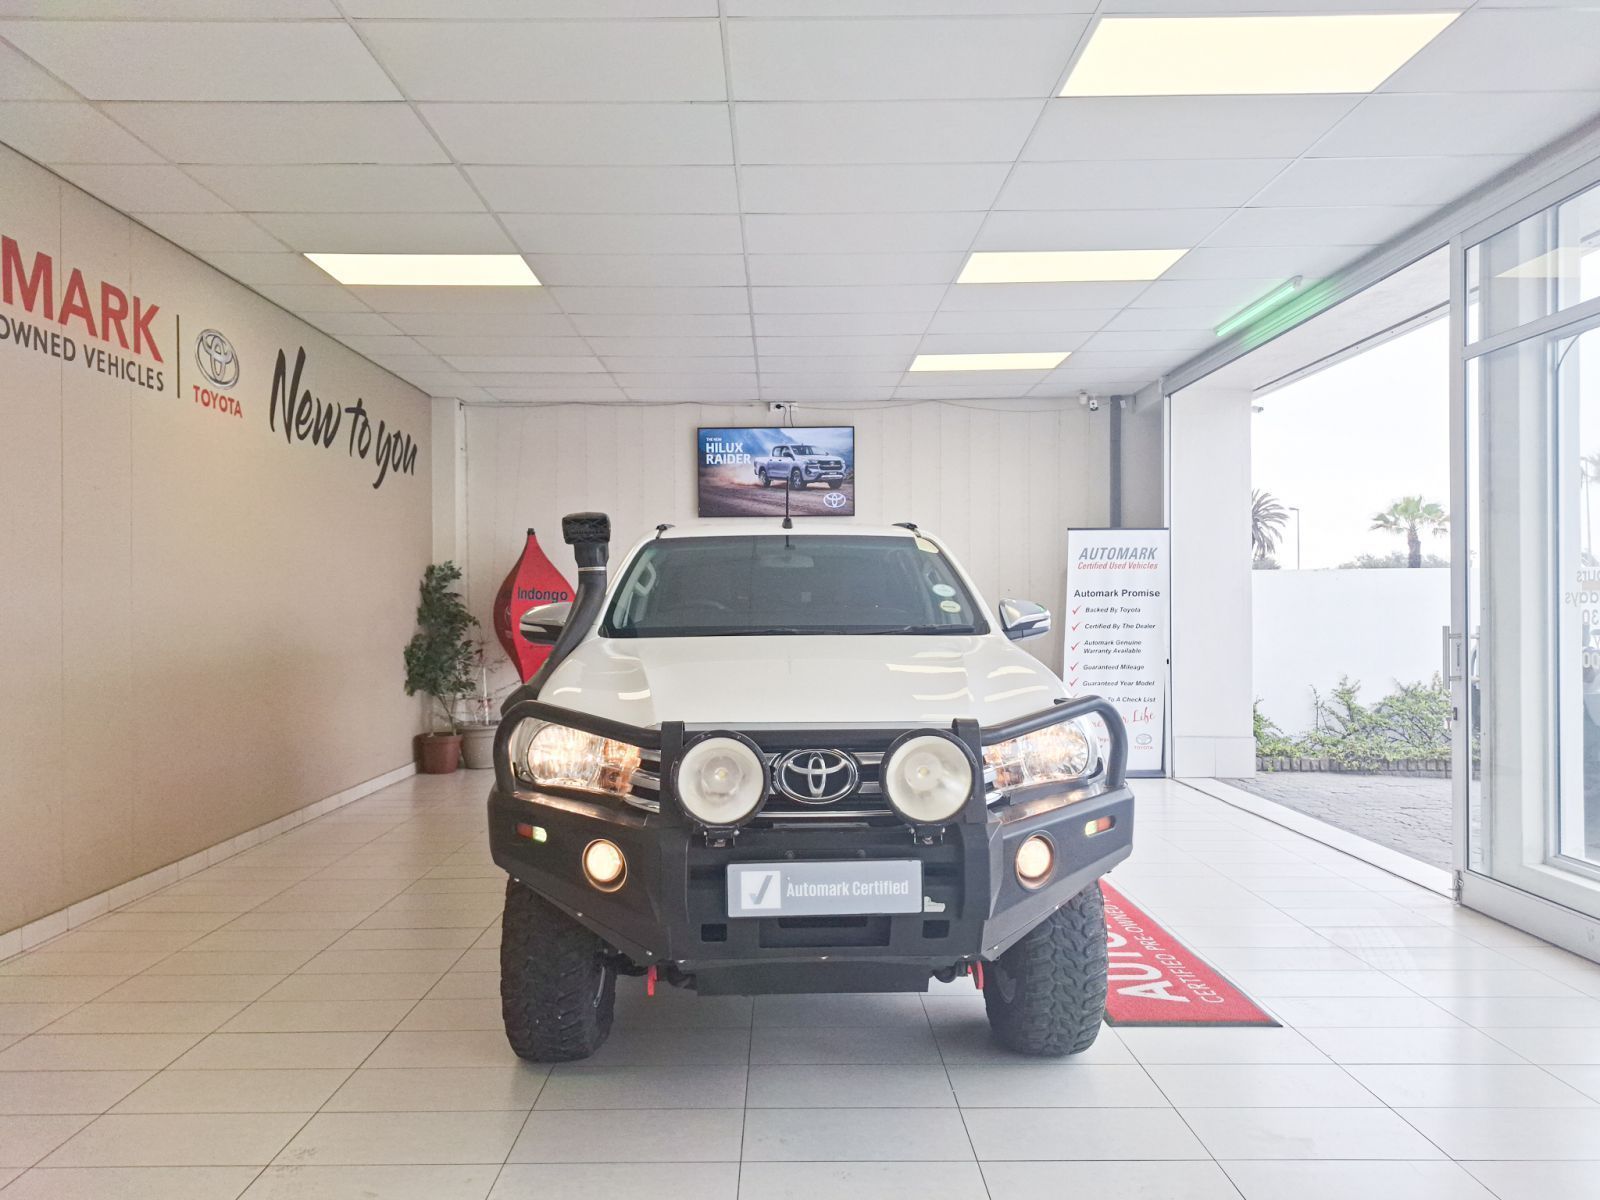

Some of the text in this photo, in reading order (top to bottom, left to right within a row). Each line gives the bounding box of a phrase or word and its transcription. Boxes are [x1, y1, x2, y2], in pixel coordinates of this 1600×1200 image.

[1, 234, 164, 364] MARK
[84, 343, 164, 392] VEHICLES
[193, 384, 243, 418] TOYOTA
[269, 346, 418, 489] New to you
[705, 442, 743, 453] HILUX
[706, 453, 751, 465] RAIDER
[1078, 547, 1158, 560] AUTOMARK
[1077, 561, 1158, 570] Certified Used Vehicles
[517, 587, 568, 603] Indongo
[1073, 588, 1161, 598] Automark Promise
[1109, 606, 1118, 614] By
[1120, 606, 1141, 614] Toyota
[1084, 622, 1156, 631] Certified By The Dealer
[1133, 706, 1154, 724] Life
[786, 878, 909, 897] Automark Certified
[1104, 904, 1225, 1004] CERTIFIED PRE-OWNED
